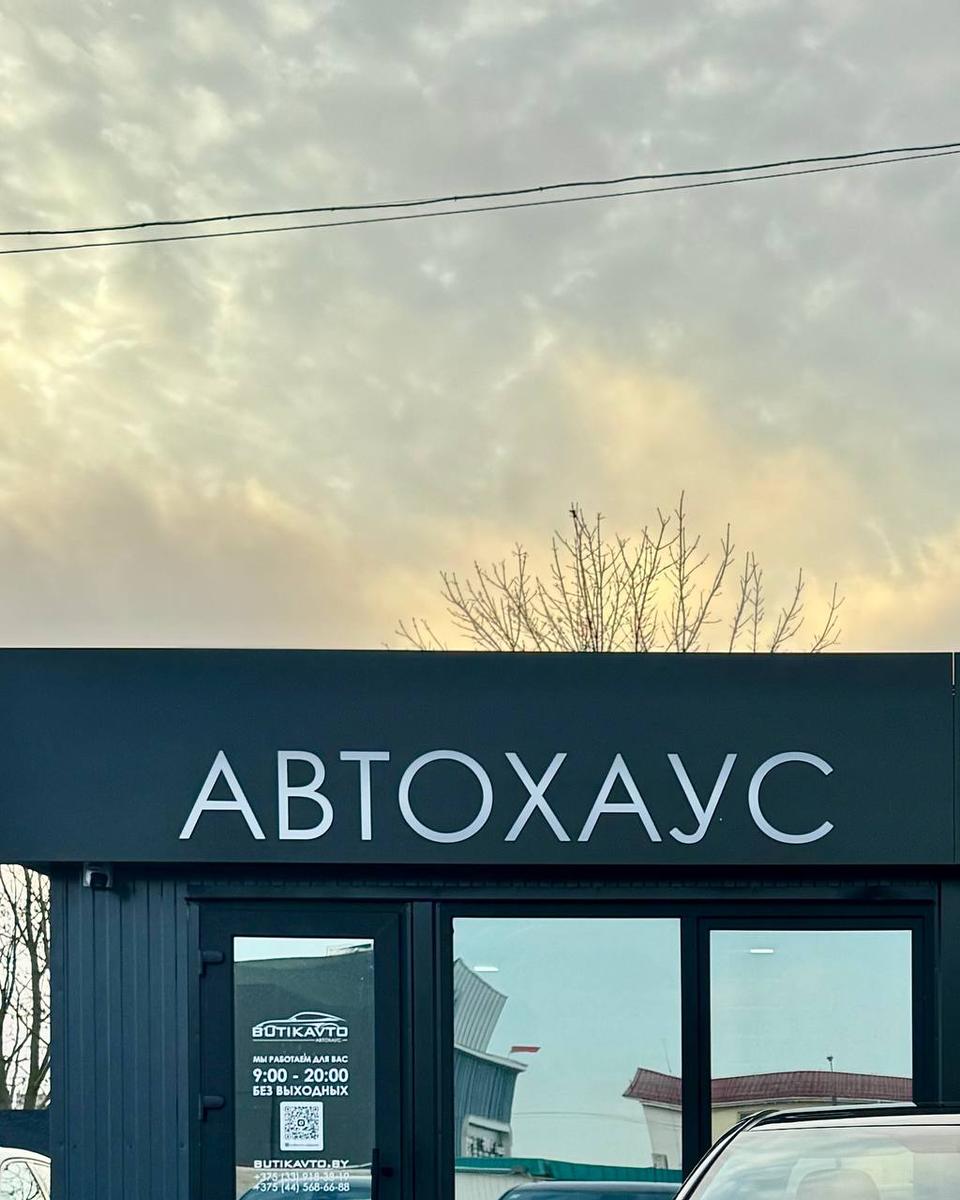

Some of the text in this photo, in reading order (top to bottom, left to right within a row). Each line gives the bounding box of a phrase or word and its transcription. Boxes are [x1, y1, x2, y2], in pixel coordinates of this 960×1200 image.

[179, 749, 834, 844] АВТОХАУС
[252, 1025, 348, 1037] BUTIKAVTO
[252, 1055, 267, 1063] МЫ
[269, 1055, 311, 1063] РАБОТАЕМ
[331, 1055, 348, 1063] ВАС
[252, 1068, 287, 1083] 9:00
[304, 1068, 349, 1083] 20:00
[252, 1085, 348, 1097] БЕЗ ВЫХОДНЫХ
[253, 1159, 349, 1168] BUTIKAVTO.BY
[253, 1183, 350, 1194] +375 (44) 568-66-88
